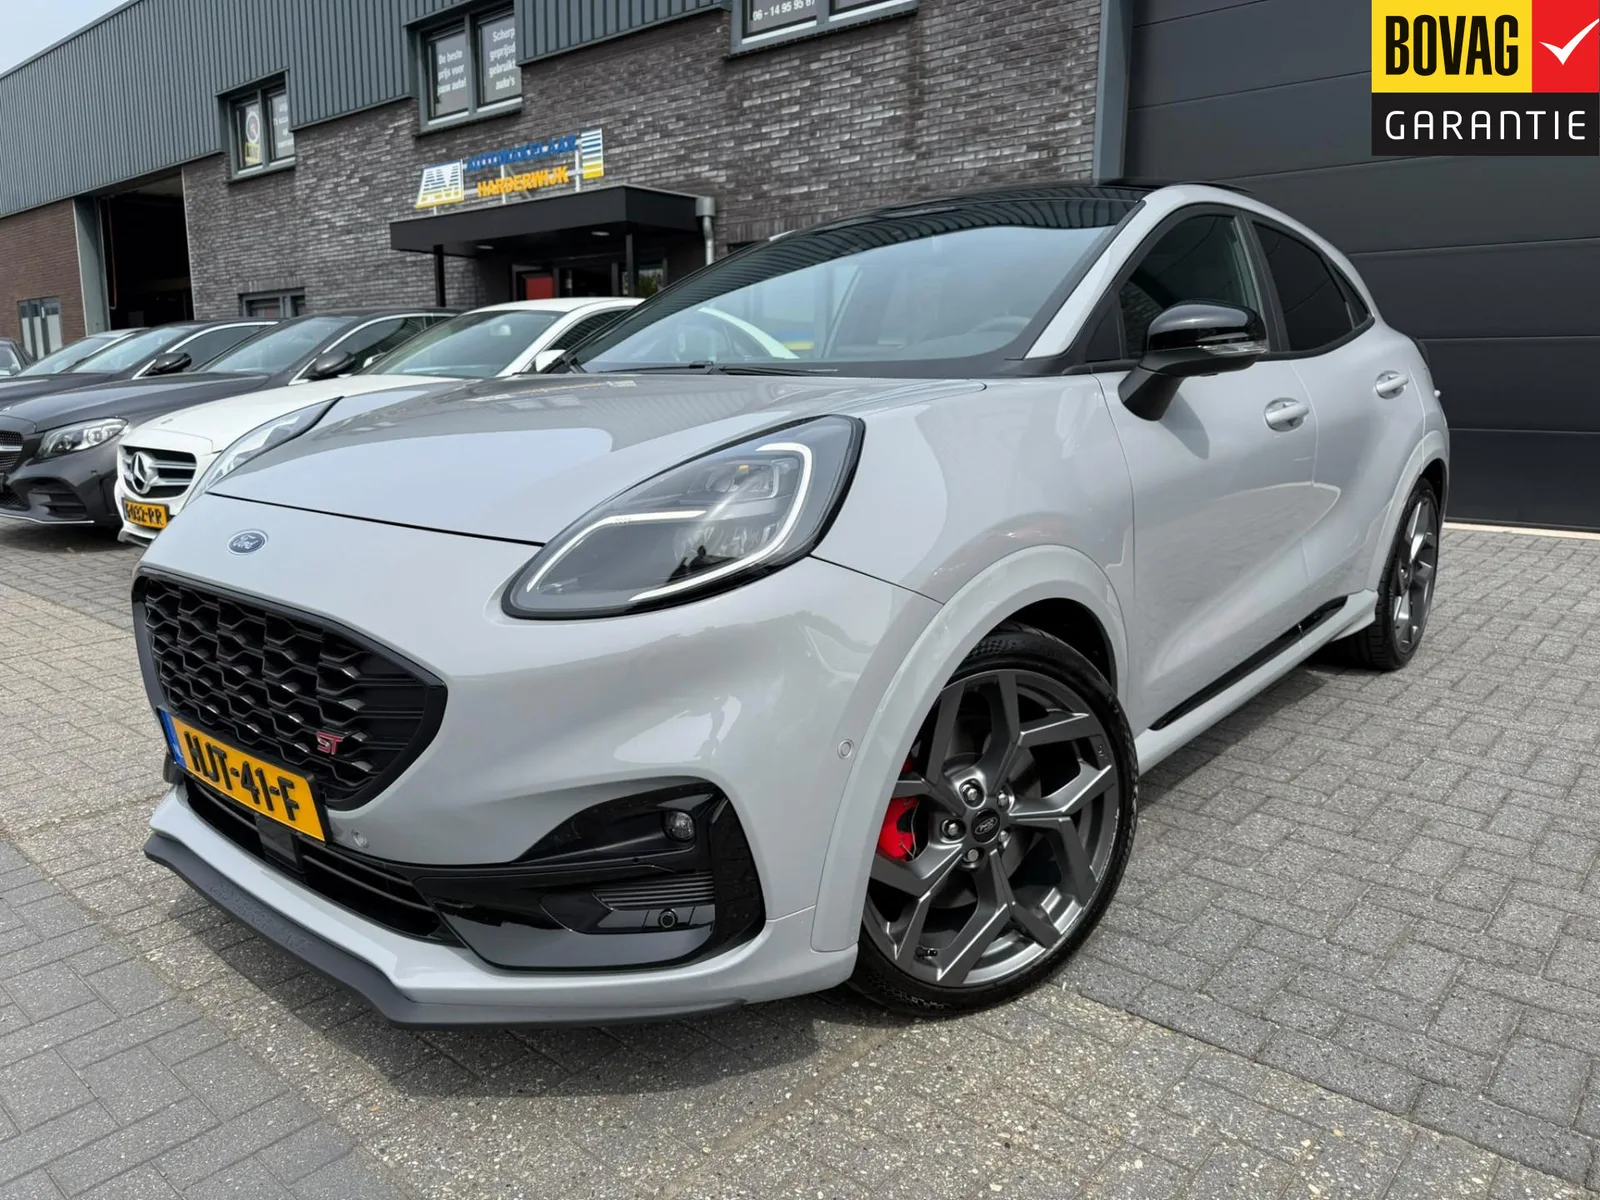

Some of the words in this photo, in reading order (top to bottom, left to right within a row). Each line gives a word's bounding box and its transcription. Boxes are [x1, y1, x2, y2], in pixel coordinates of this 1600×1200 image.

[492, 27, 516, 43] Scherp
[446, 49, 463, 62] beste
[438, 67, 451, 82] prijs
[451, 64, 465, 76] voor
[495, 75, 516, 91] auto's
[477, 165, 569, 197] HARDERWIJK
[315, 731, 344, 755] ST
[184, 731, 300, 821] HJT-41-F
